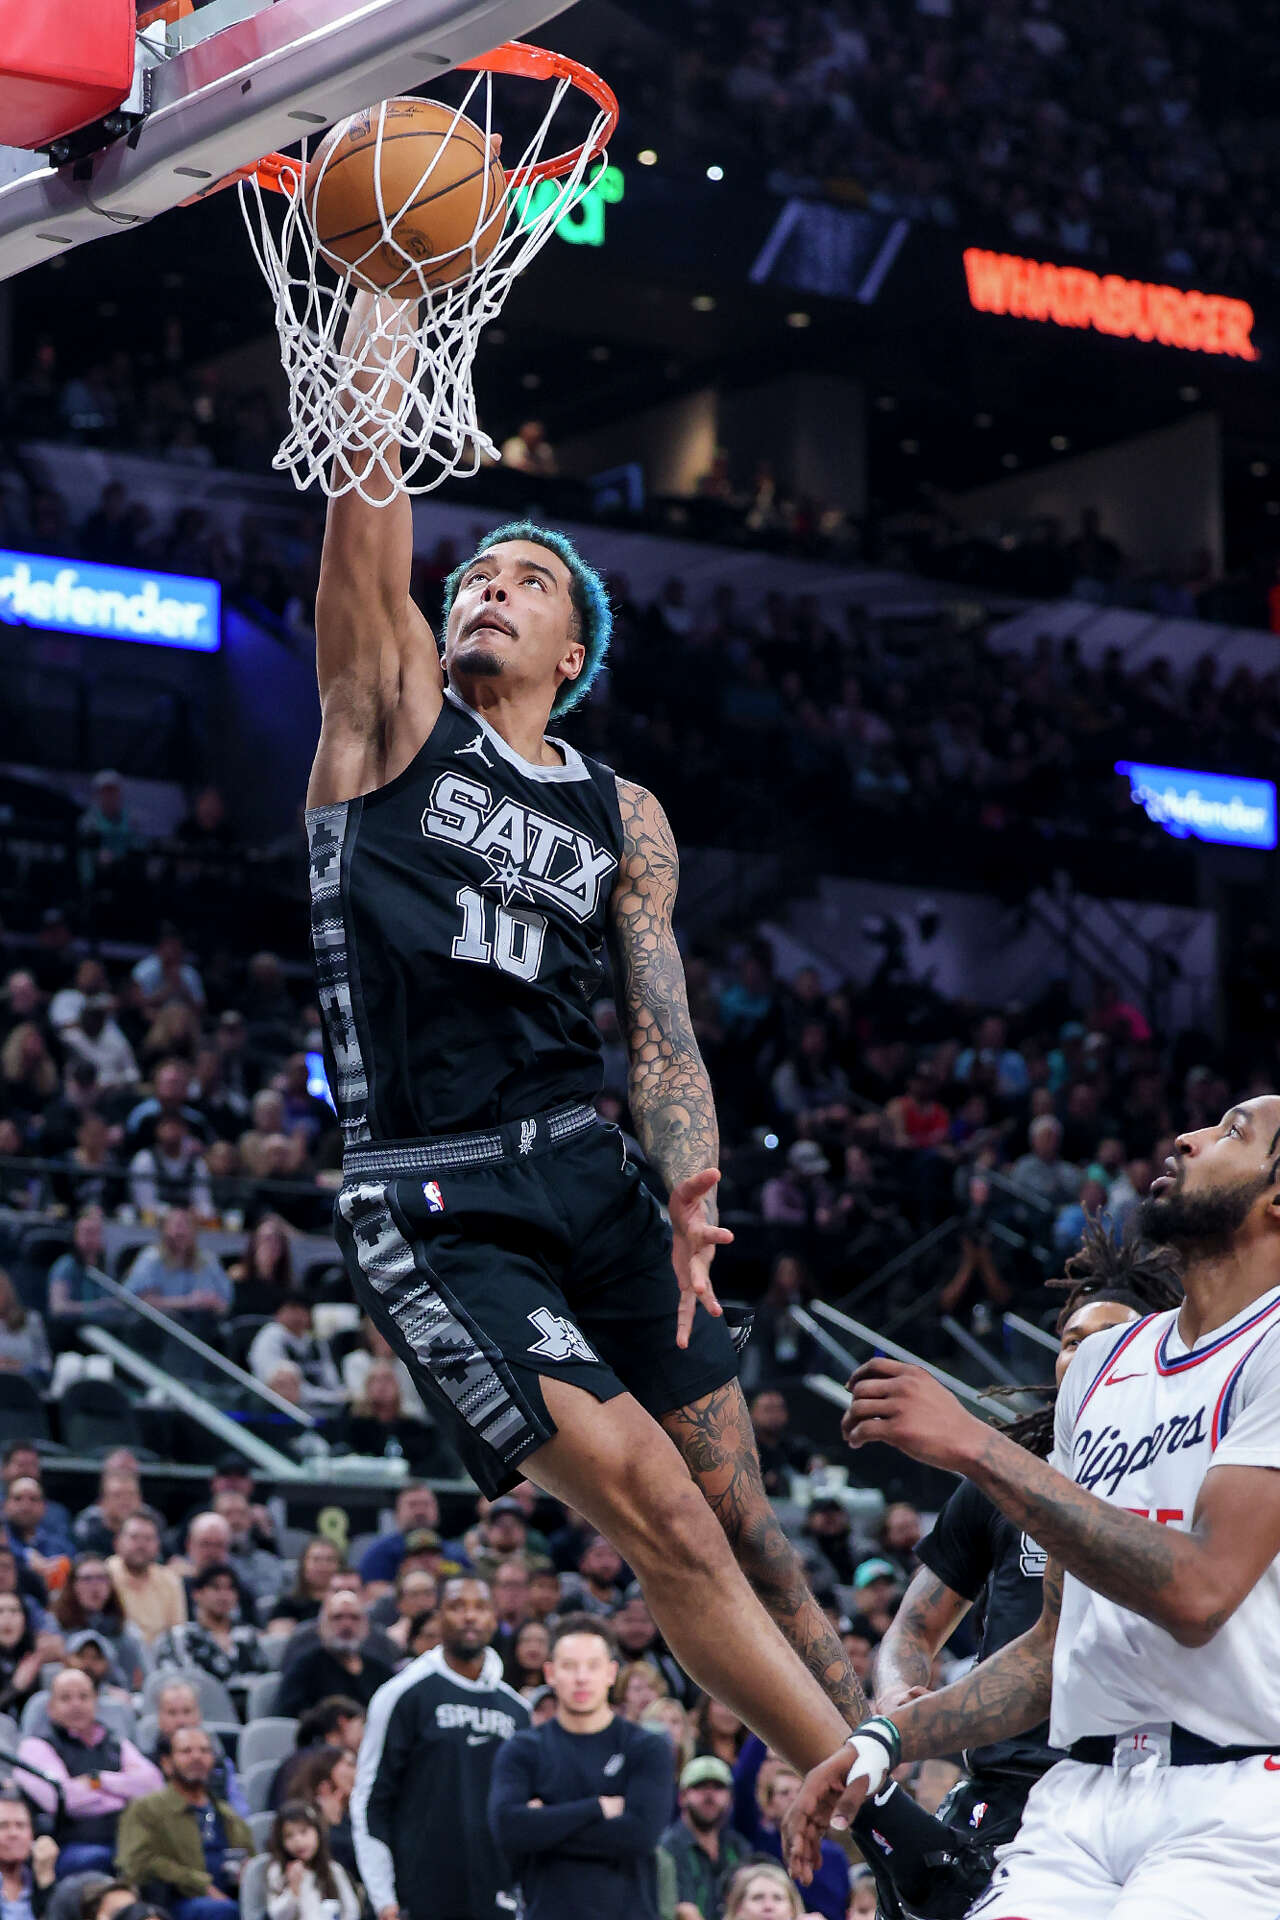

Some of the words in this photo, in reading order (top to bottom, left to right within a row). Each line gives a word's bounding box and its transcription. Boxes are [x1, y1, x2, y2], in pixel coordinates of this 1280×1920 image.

[963, 248, 1257, 361] WHATABURGER
[421, 771, 618, 923] SATX
[451, 885, 548, 982] 10
[1073, 1406, 1207, 1496] Clippers
